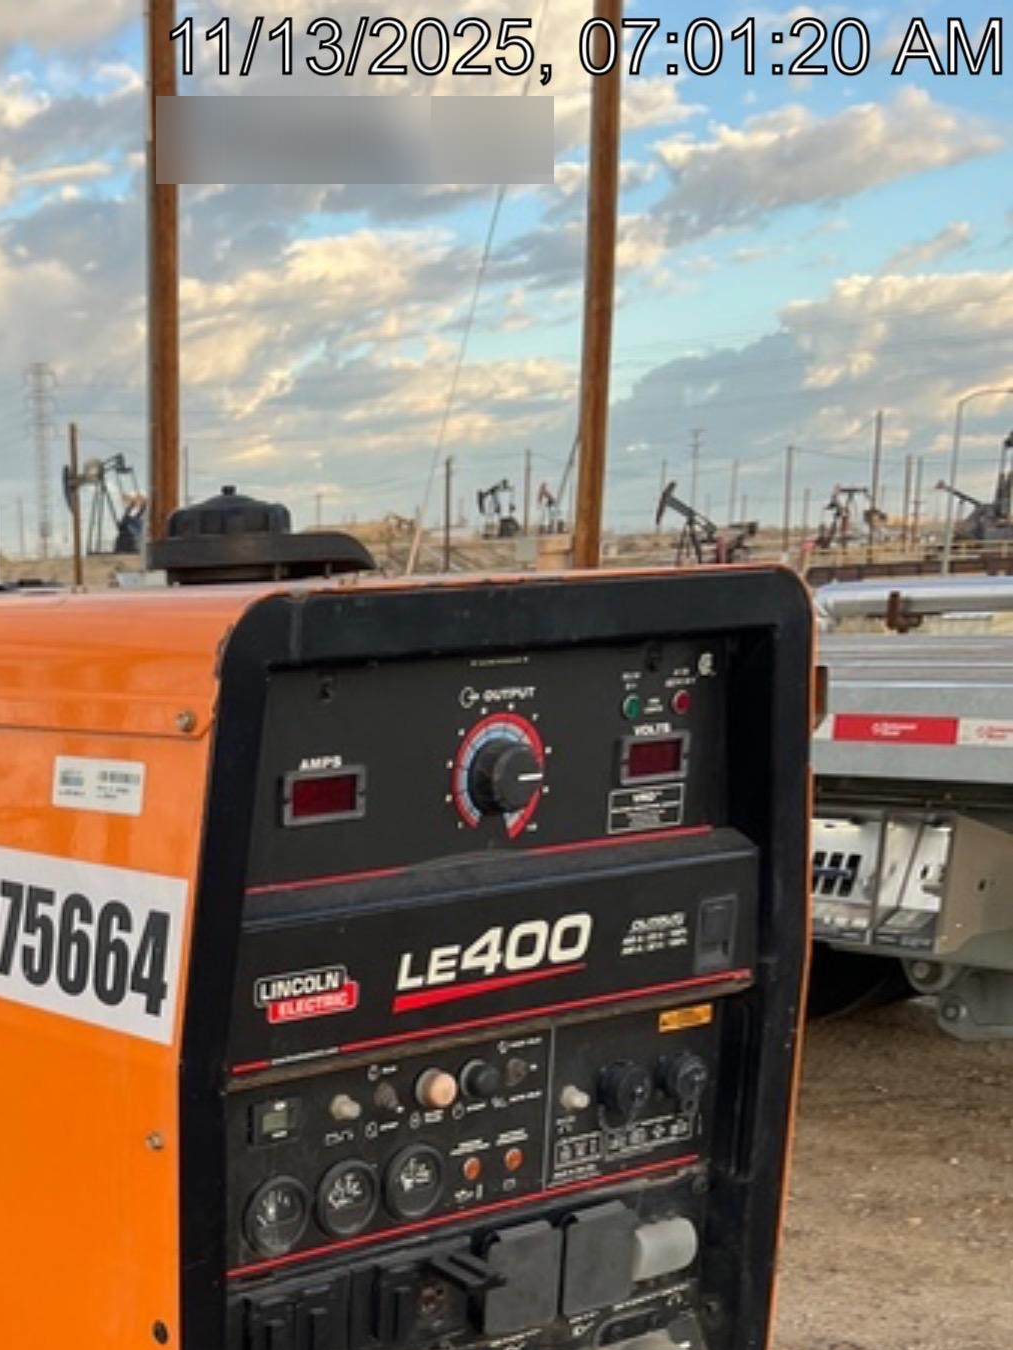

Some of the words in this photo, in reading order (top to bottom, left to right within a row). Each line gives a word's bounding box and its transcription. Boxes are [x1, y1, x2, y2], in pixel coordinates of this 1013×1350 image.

[482, 686, 537, 702] OUTPUT
[299, 755, 343, 769] AMPS
[396, 912, 593, 991] LE400
[259, 971, 340, 1001] LINCOLN
[278, 990, 349, 1016] ELECTRIC
